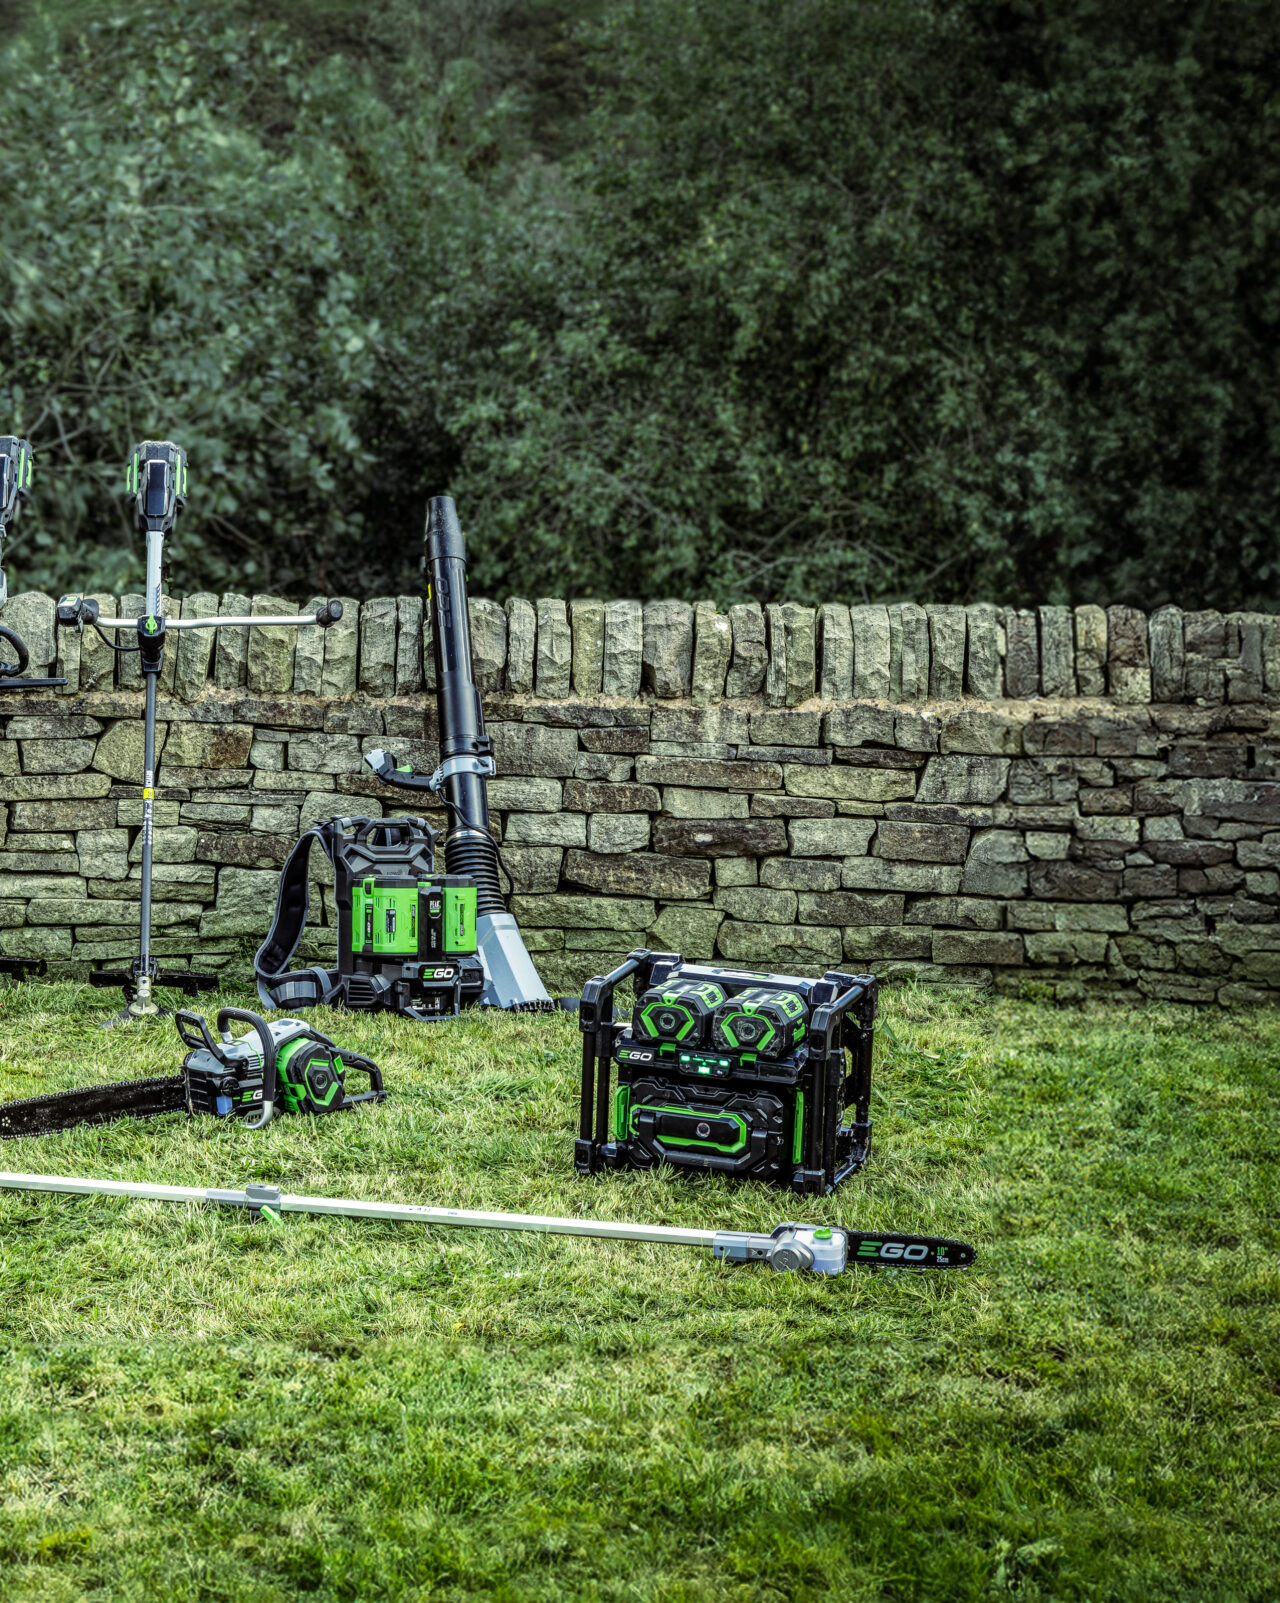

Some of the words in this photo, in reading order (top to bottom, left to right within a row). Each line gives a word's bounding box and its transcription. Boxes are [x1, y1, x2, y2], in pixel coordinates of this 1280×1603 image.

[422, 968, 454, 979] EGO
[618, 1049, 652, 1061] EGO
[241, 1089, 263, 1102] EG
[856, 1240, 929, 1261] EGO
